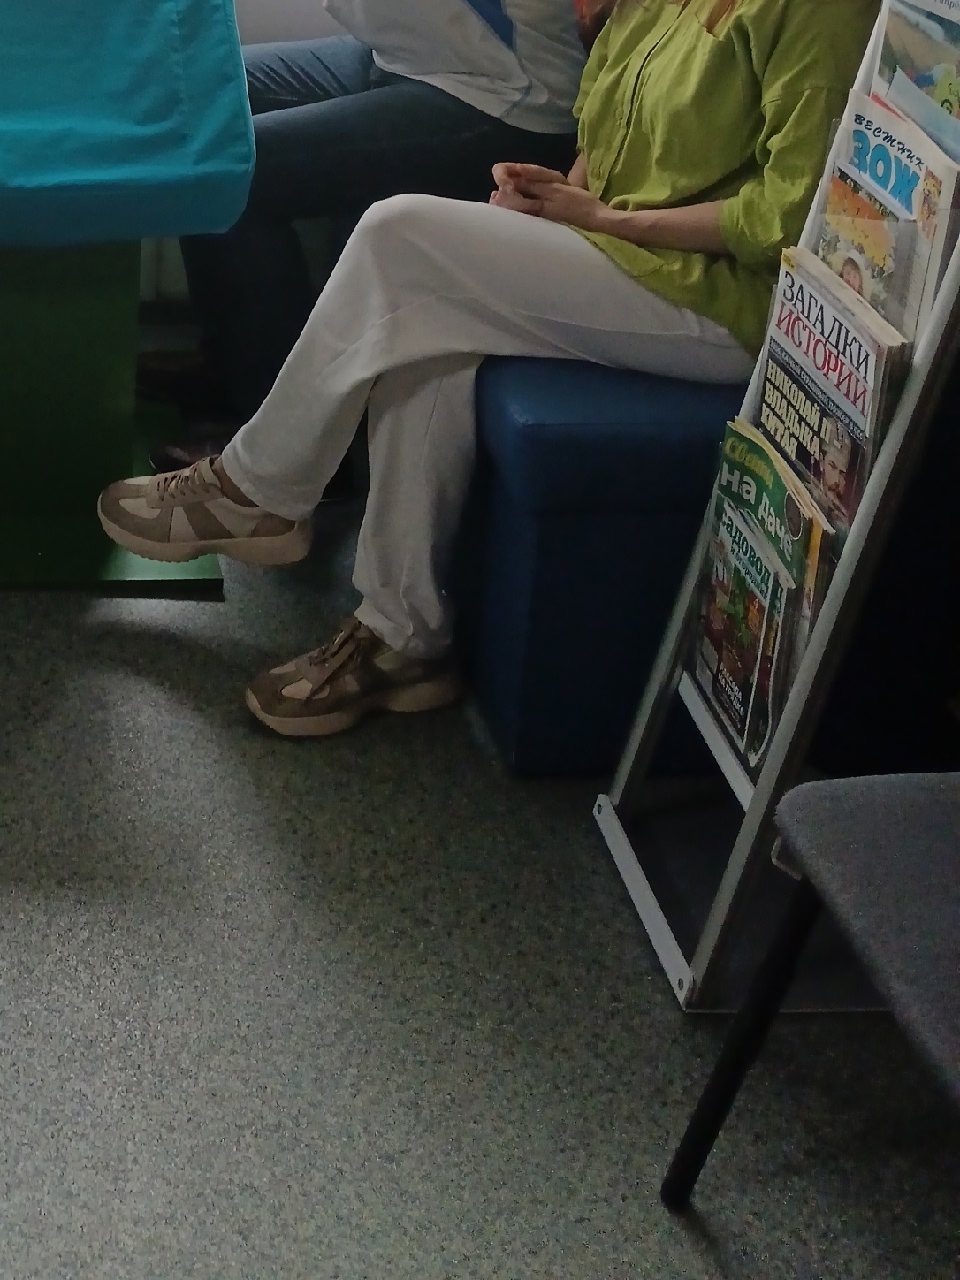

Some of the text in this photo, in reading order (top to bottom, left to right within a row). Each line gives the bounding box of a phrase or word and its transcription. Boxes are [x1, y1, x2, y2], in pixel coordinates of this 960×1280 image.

[849, 129, 921, 215] ЗОЖ
[854, 114, 925, 171] ВЕСТНИК
[775, 300, 868, 418] ИСТОРИИ
[783, 270, 871, 384] ЗАГАДКИ
[764, 380, 820, 461] ВЛАДЫКА
[766, 359, 820, 432] НИКОЛАЙ
